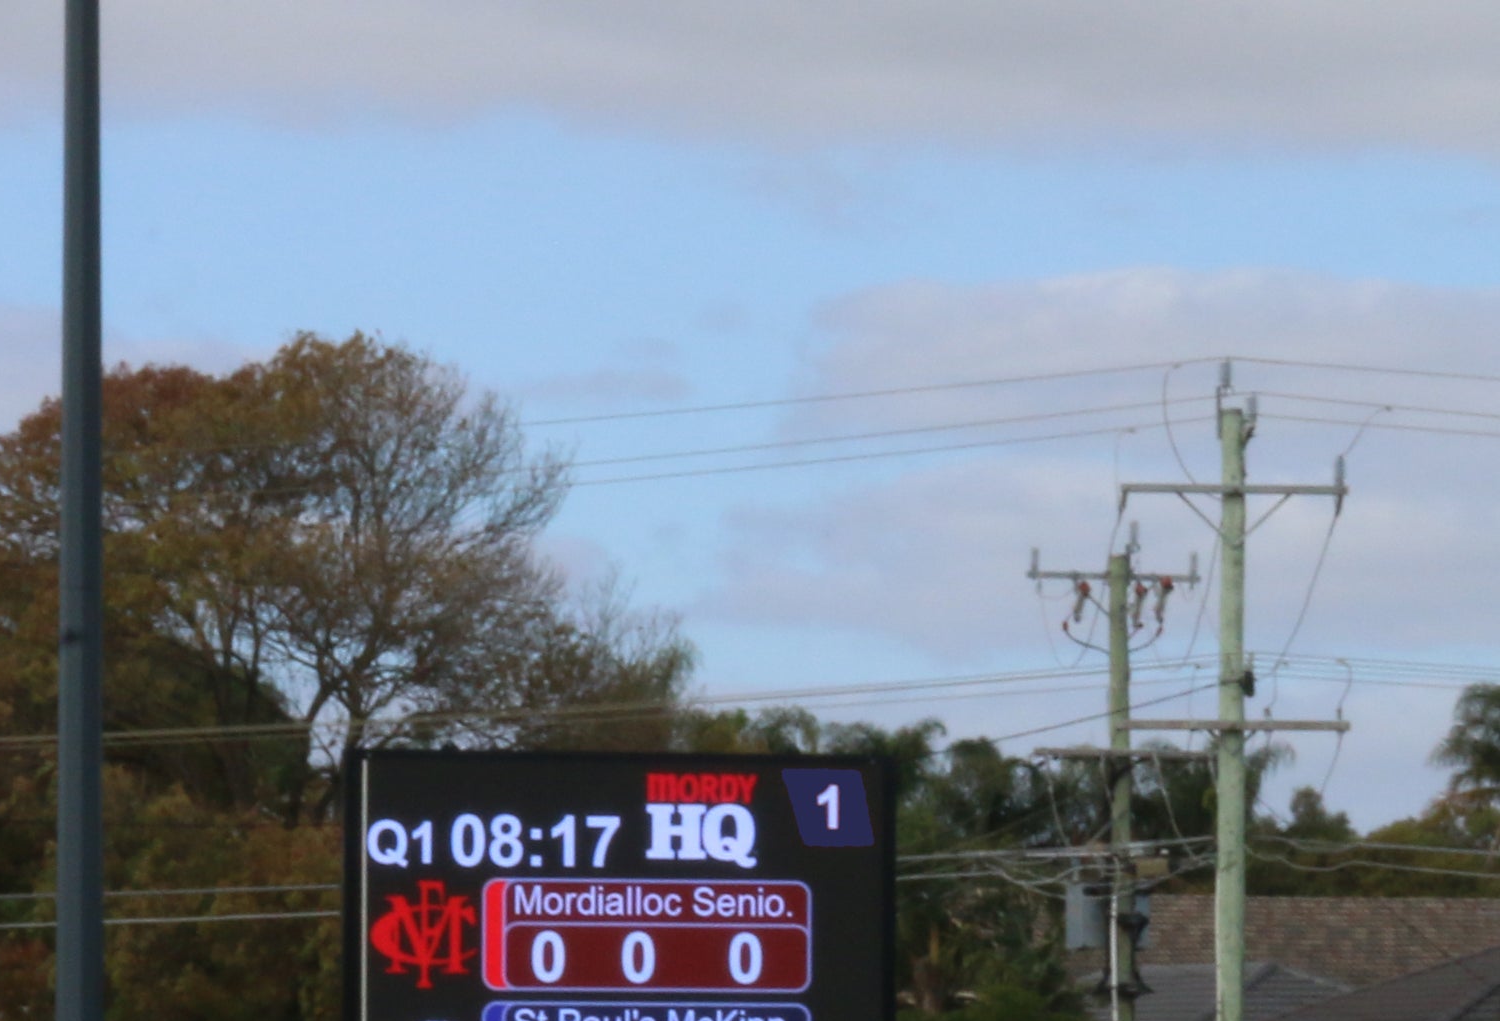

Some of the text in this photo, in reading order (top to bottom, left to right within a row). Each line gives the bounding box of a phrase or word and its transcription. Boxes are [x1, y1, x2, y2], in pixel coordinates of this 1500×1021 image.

[816, 784, 840, 830] 1
[366, 813, 621, 868] Q1 08:17
[645, 803, 758, 869] HQ
[513, 884, 793, 917] Mordialloc Senio.
[531, 930, 763, 985] 0 0 0
